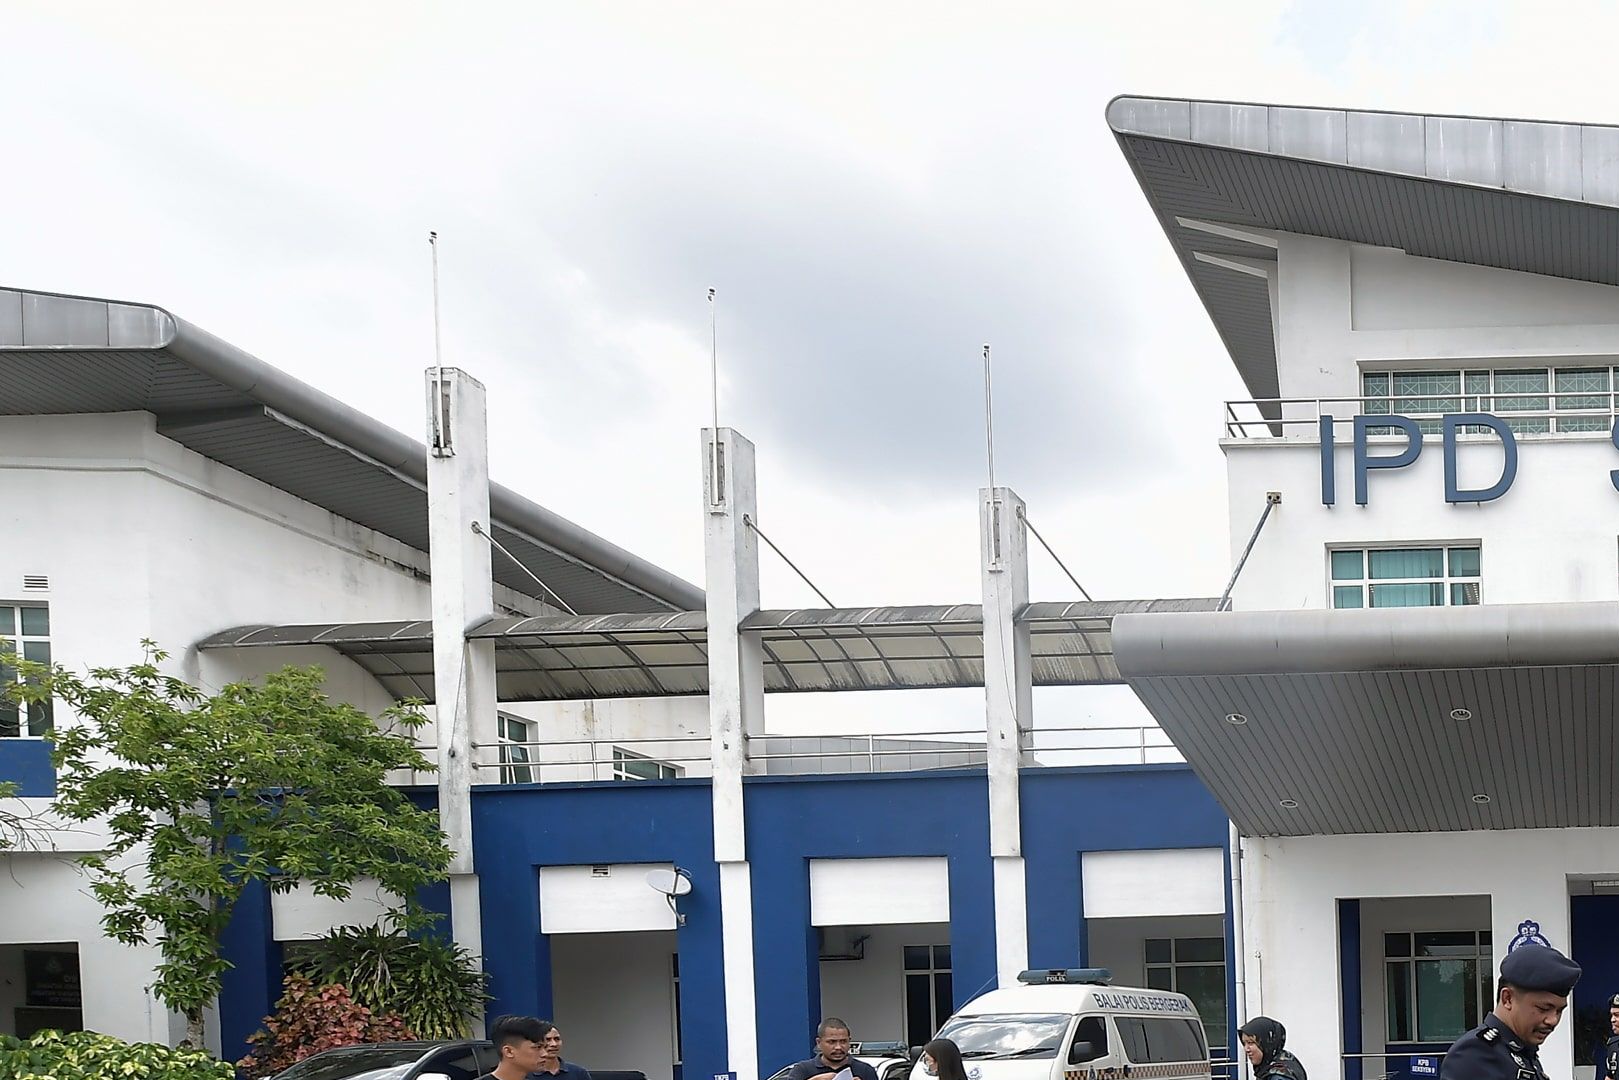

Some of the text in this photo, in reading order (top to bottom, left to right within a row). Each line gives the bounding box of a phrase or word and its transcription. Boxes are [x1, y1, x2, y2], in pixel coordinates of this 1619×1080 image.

[1319, 413, 1518, 506] IPD
[1093, 993, 1192, 1012] BALAI POLIS BERGERAK
